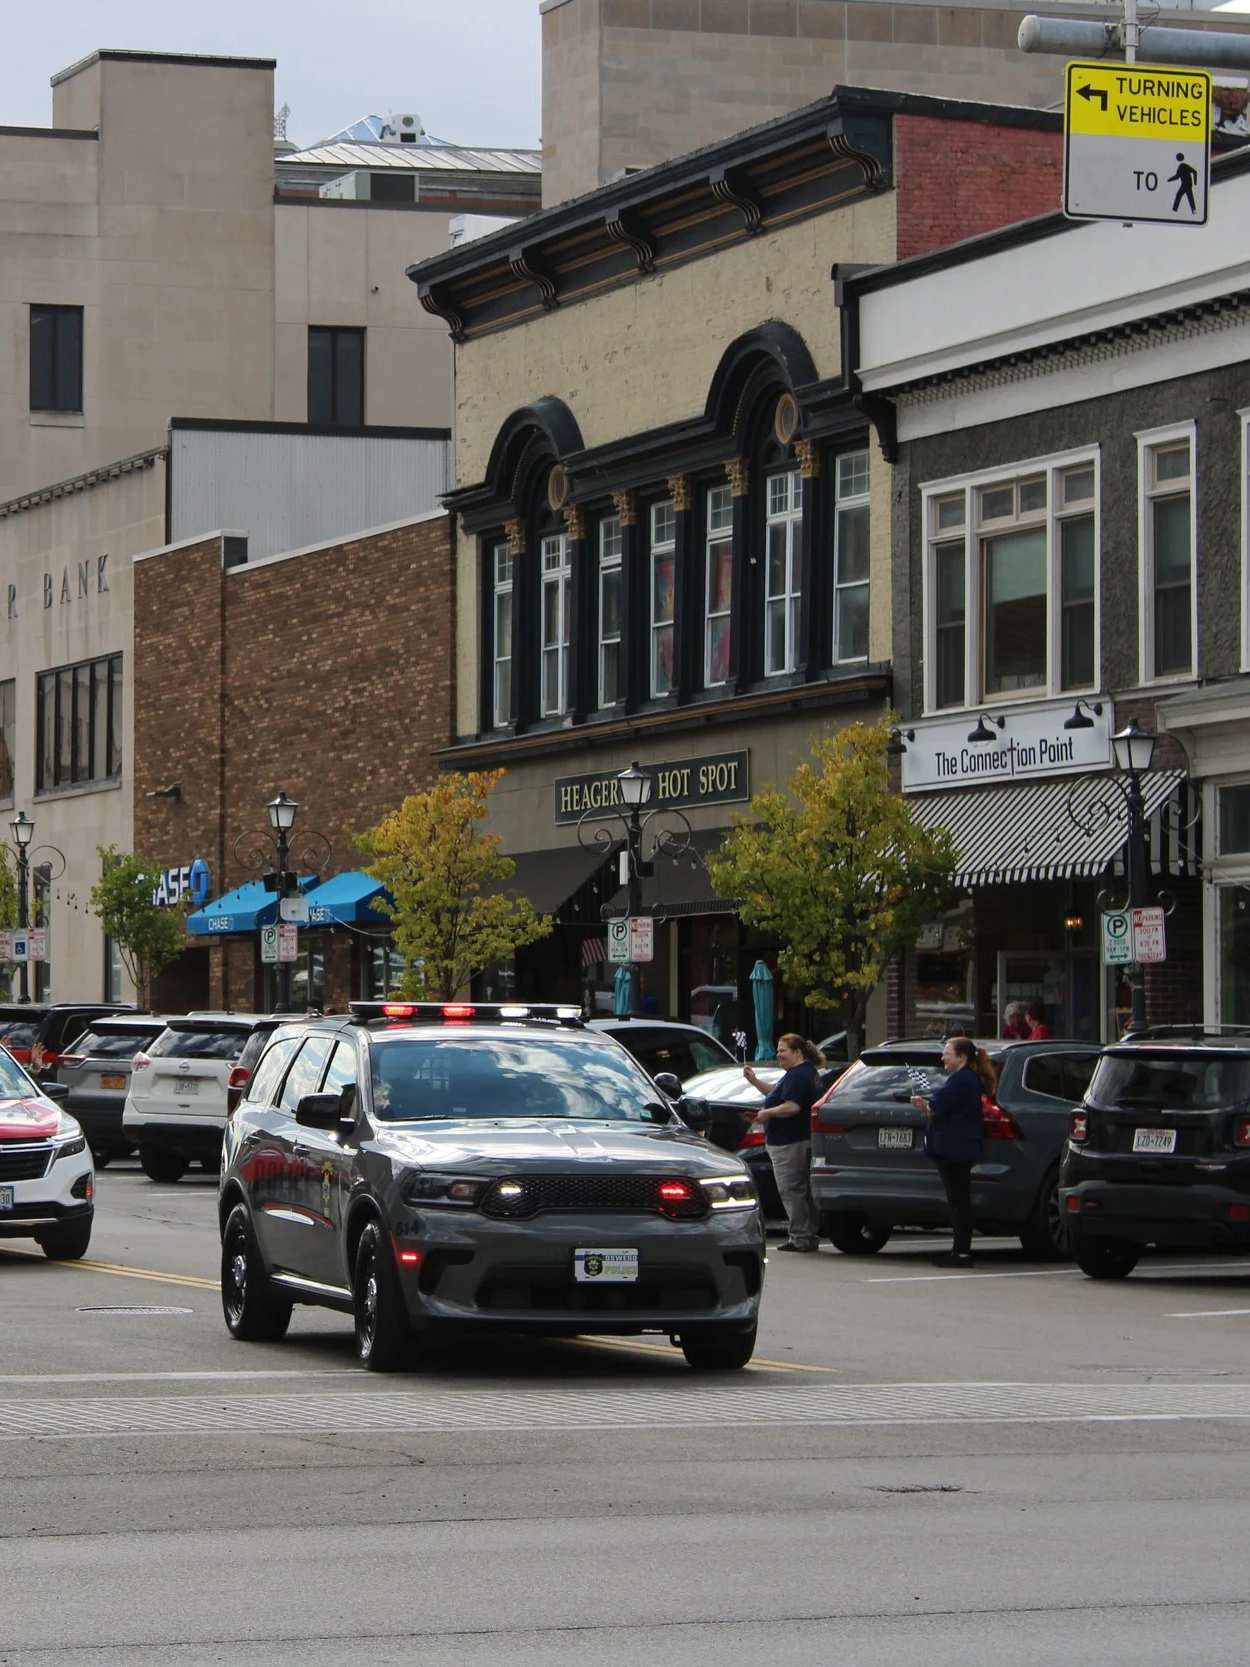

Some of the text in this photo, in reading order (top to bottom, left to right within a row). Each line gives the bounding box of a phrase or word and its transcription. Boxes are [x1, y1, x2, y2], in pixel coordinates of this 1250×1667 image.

[1116, 77, 1203, 100] TURNING
[1116, 104, 1202, 127] VEHICLES
[1133, 170, 1158, 191] TO
[43, 553, 110, 610] BANK
[935, 736, 1074, 777] The Connection Point
[560, 761, 739, 813] HEAGER HOT SPOT
[142, 865, 191, 906] ASE
[208, 916, 229, 931] CHASE
[395, 1220, 419, 1236] 614
